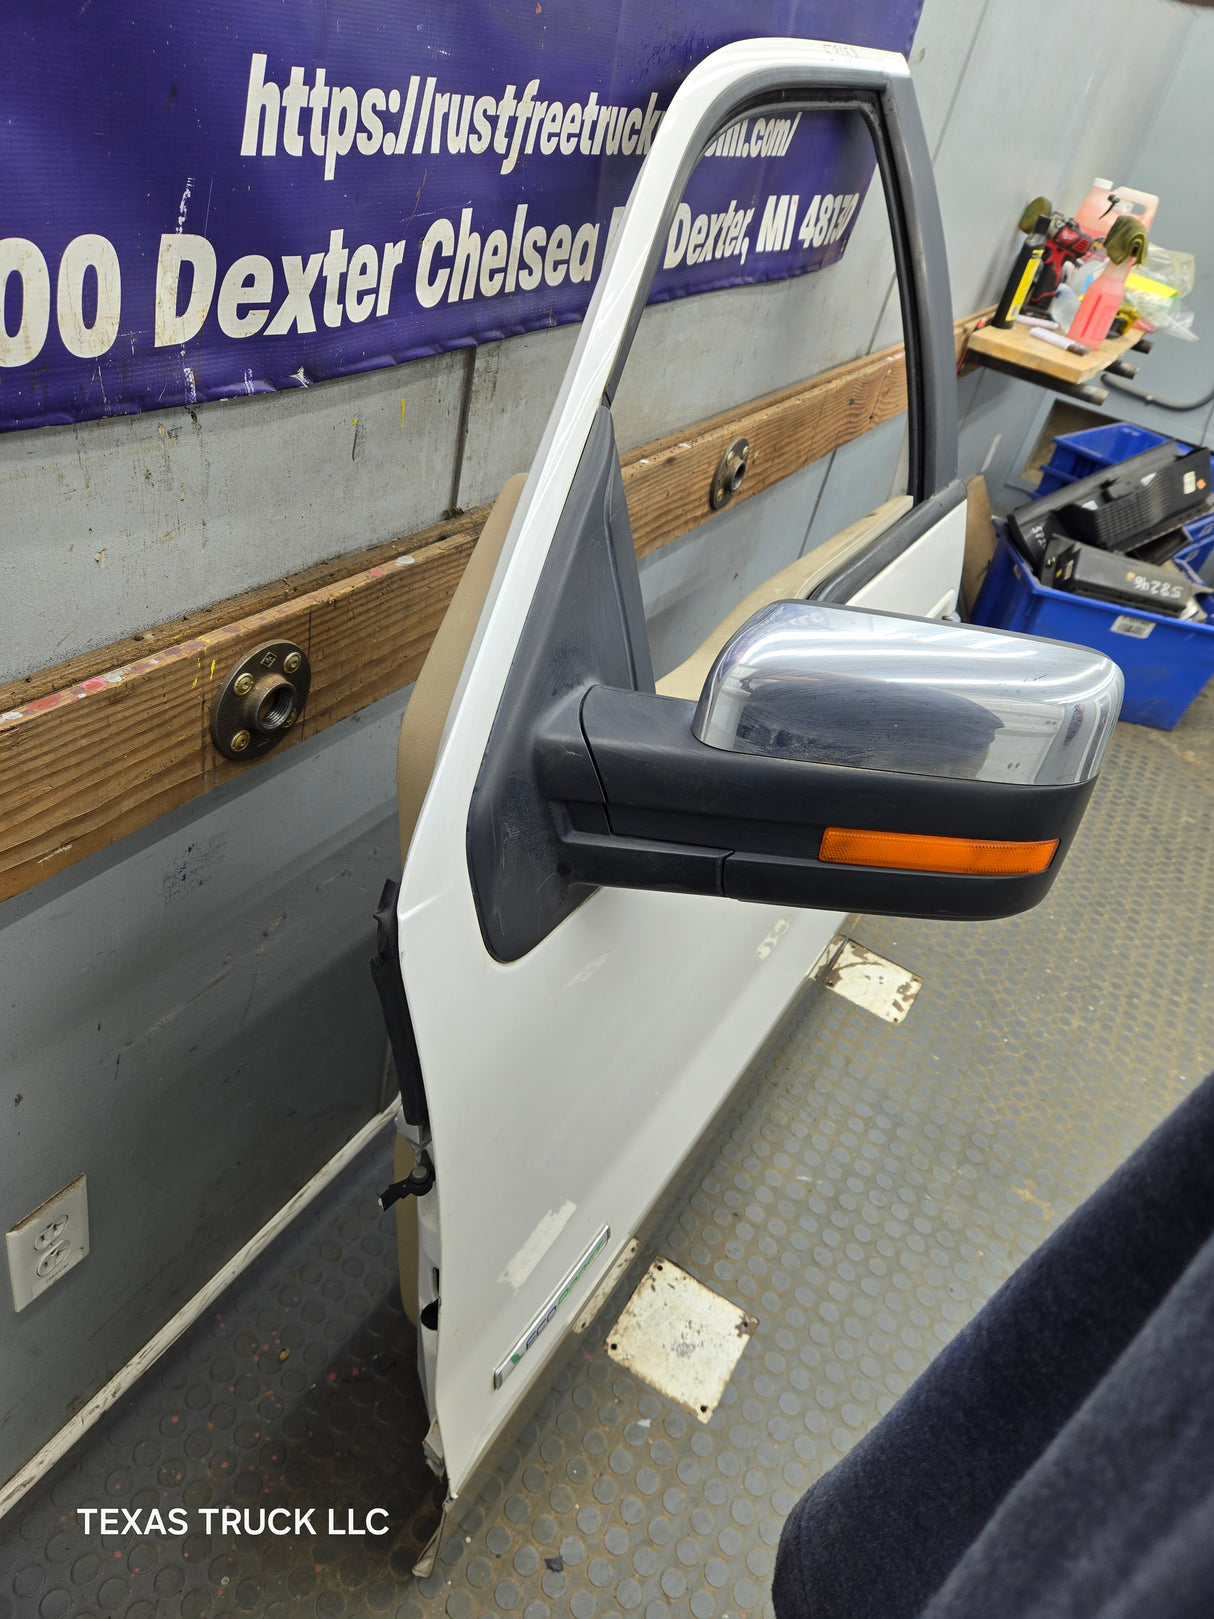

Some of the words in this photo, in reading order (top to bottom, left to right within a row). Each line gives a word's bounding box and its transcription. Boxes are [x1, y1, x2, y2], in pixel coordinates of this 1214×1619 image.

[154, 229, 406, 348] Dexter
[415, 204, 600, 309] Chelsea
[663, 199, 756, 269] Dexter,
[755, 194, 800, 254] MI
